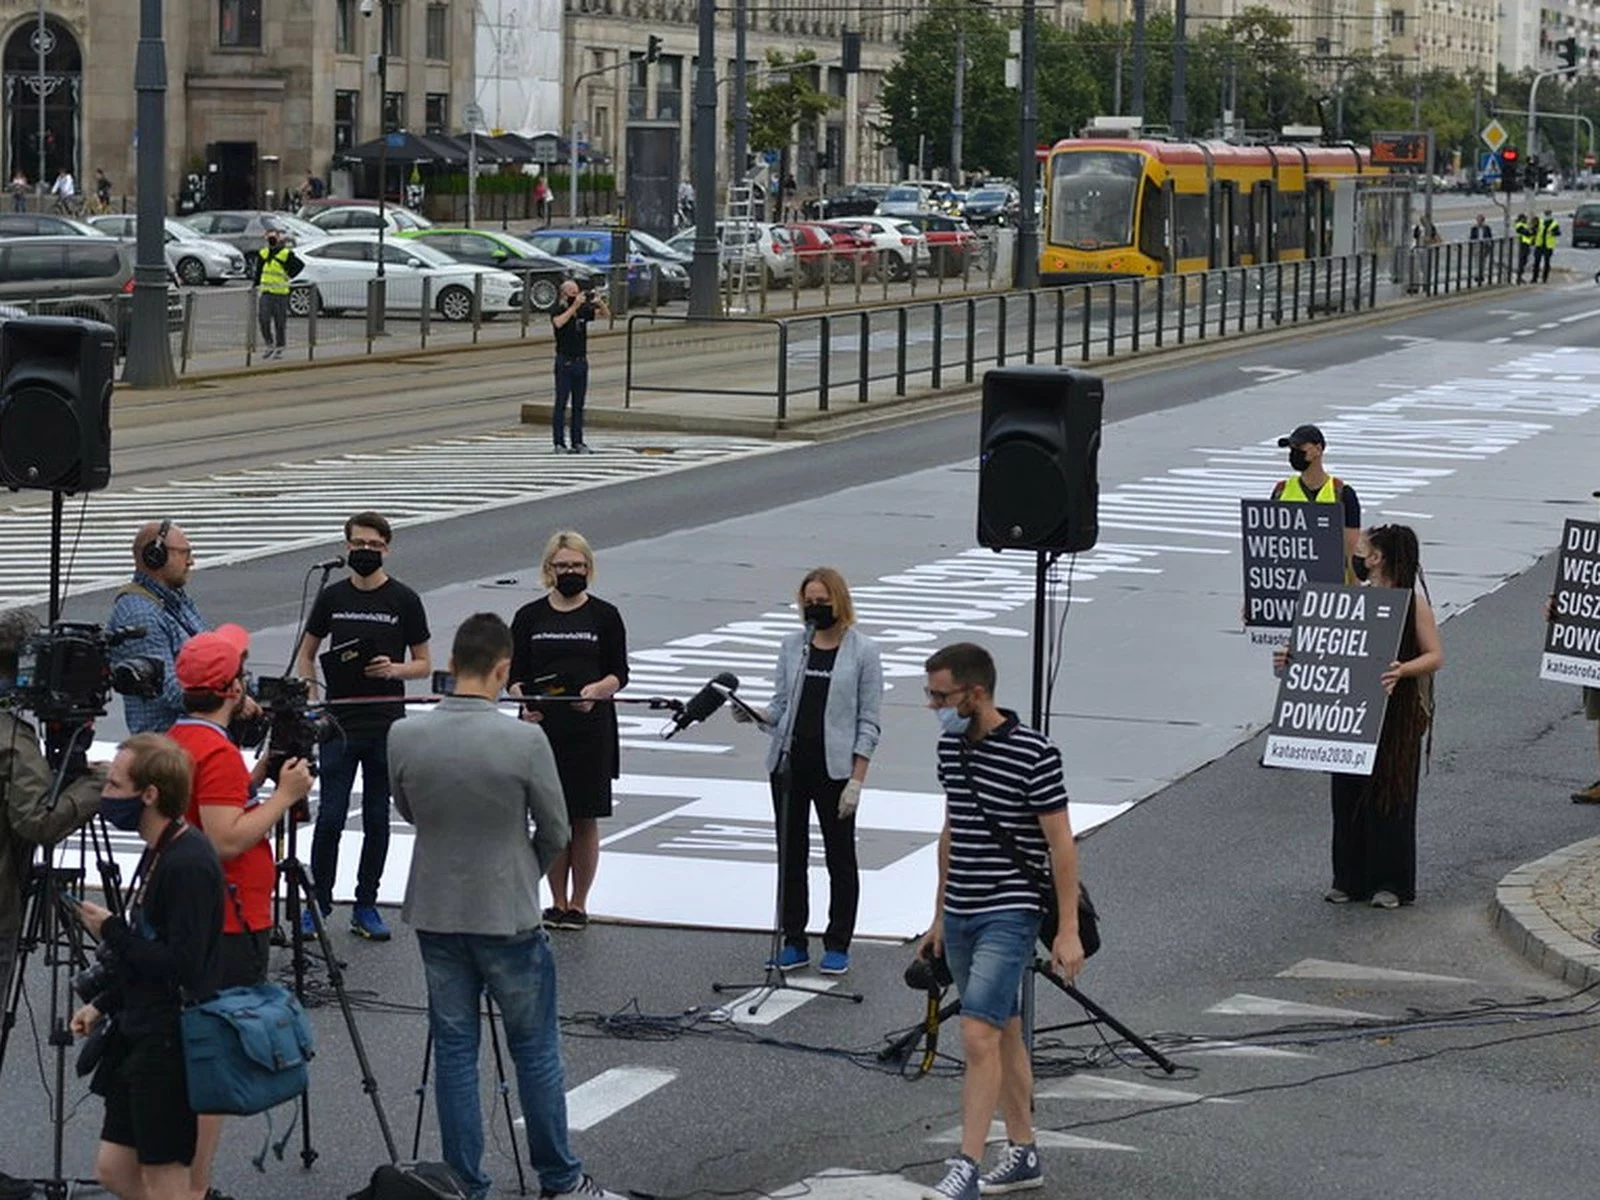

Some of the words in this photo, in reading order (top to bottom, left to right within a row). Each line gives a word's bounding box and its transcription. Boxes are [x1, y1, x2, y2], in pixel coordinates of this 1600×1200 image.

[1248, 507, 1307, 530] DUDA
[1318, 517, 1329, 527] =
[1249, 536, 1319, 563] WĘGIEL
[1567, 527, 1600, 555] DU
[1250, 567, 1308, 591] SUSZA
[1251, 598, 1299, 621] POW
[1302, 591, 1365, 621] DUDA
[1377, 605, 1391, 617] =
[1296, 626, 1370, 660] WĘGIEL
[1286, 663, 1351, 694] SUSZA
[1278, 700, 1368, 734] POWÓDŹ
[1271, 742, 1368, 769] katastrofa2030.pl
